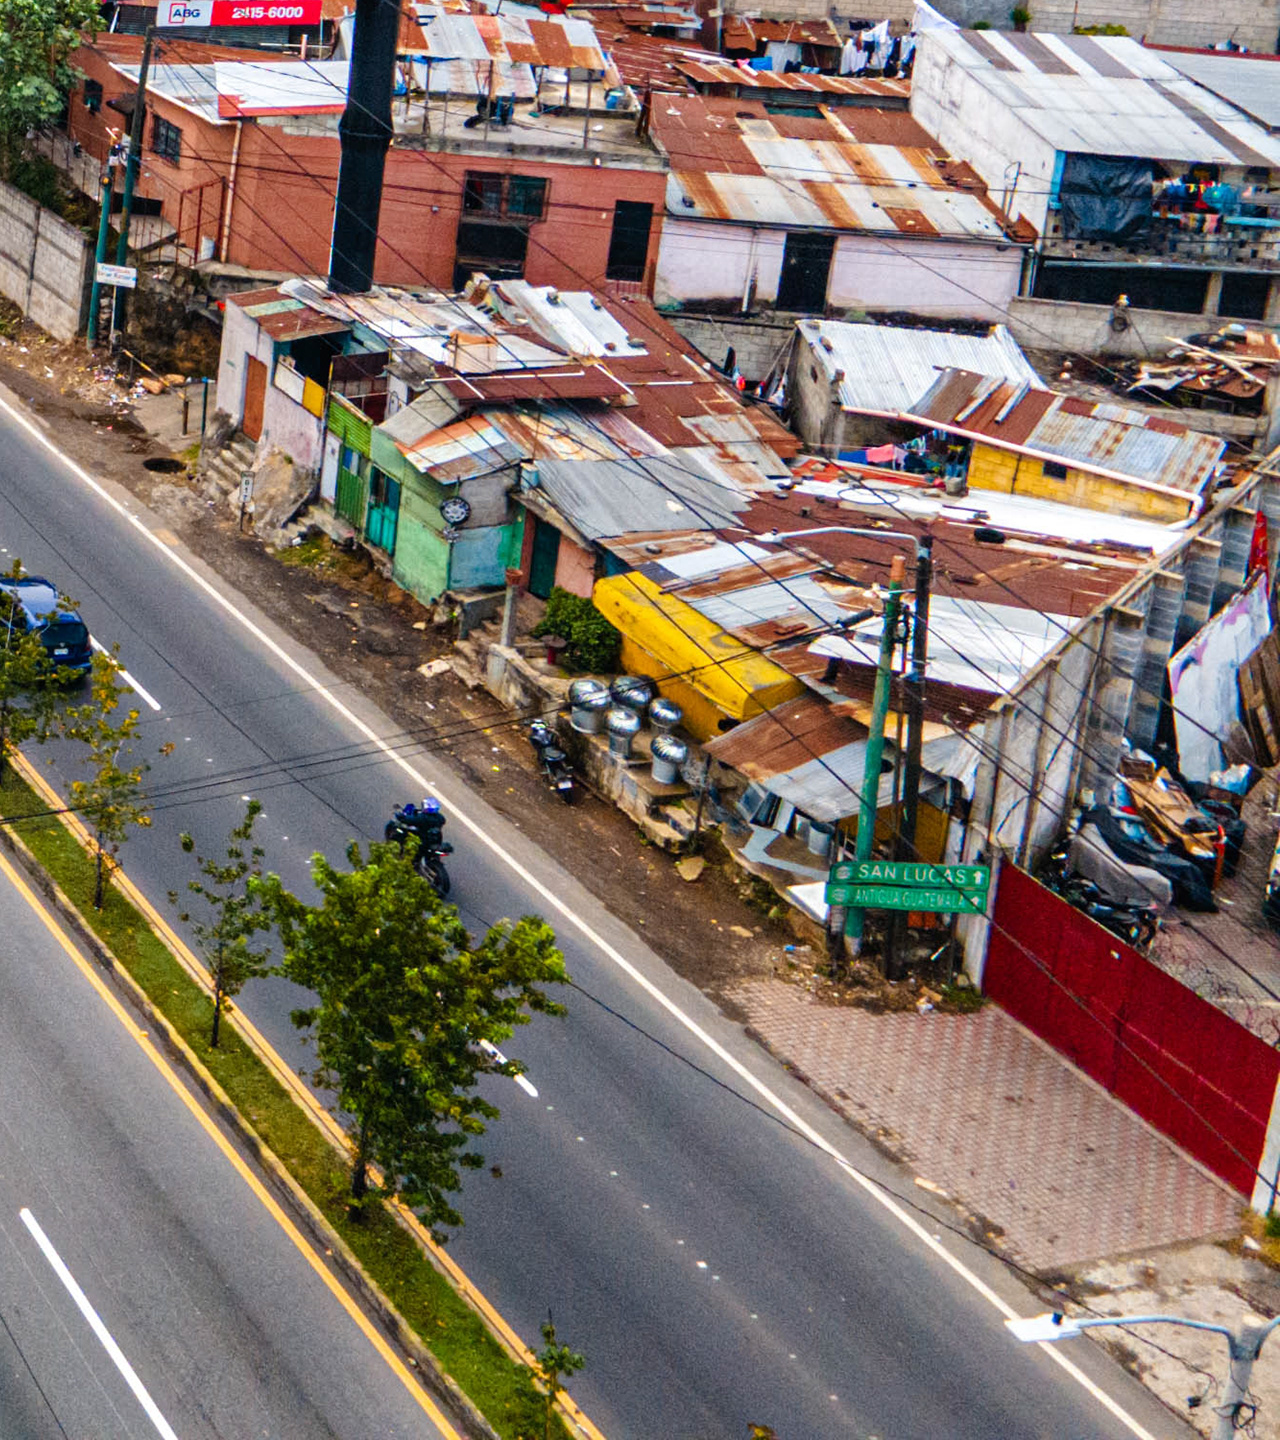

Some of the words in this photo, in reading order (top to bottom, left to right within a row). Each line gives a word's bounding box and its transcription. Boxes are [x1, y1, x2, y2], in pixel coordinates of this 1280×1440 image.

[858, 864, 896, 879] SAN
[904, 867, 966, 883] LUCAS
[854, 890, 898, 906] ANTIGUA
[902, 892, 965, 908] GUATEMALA
